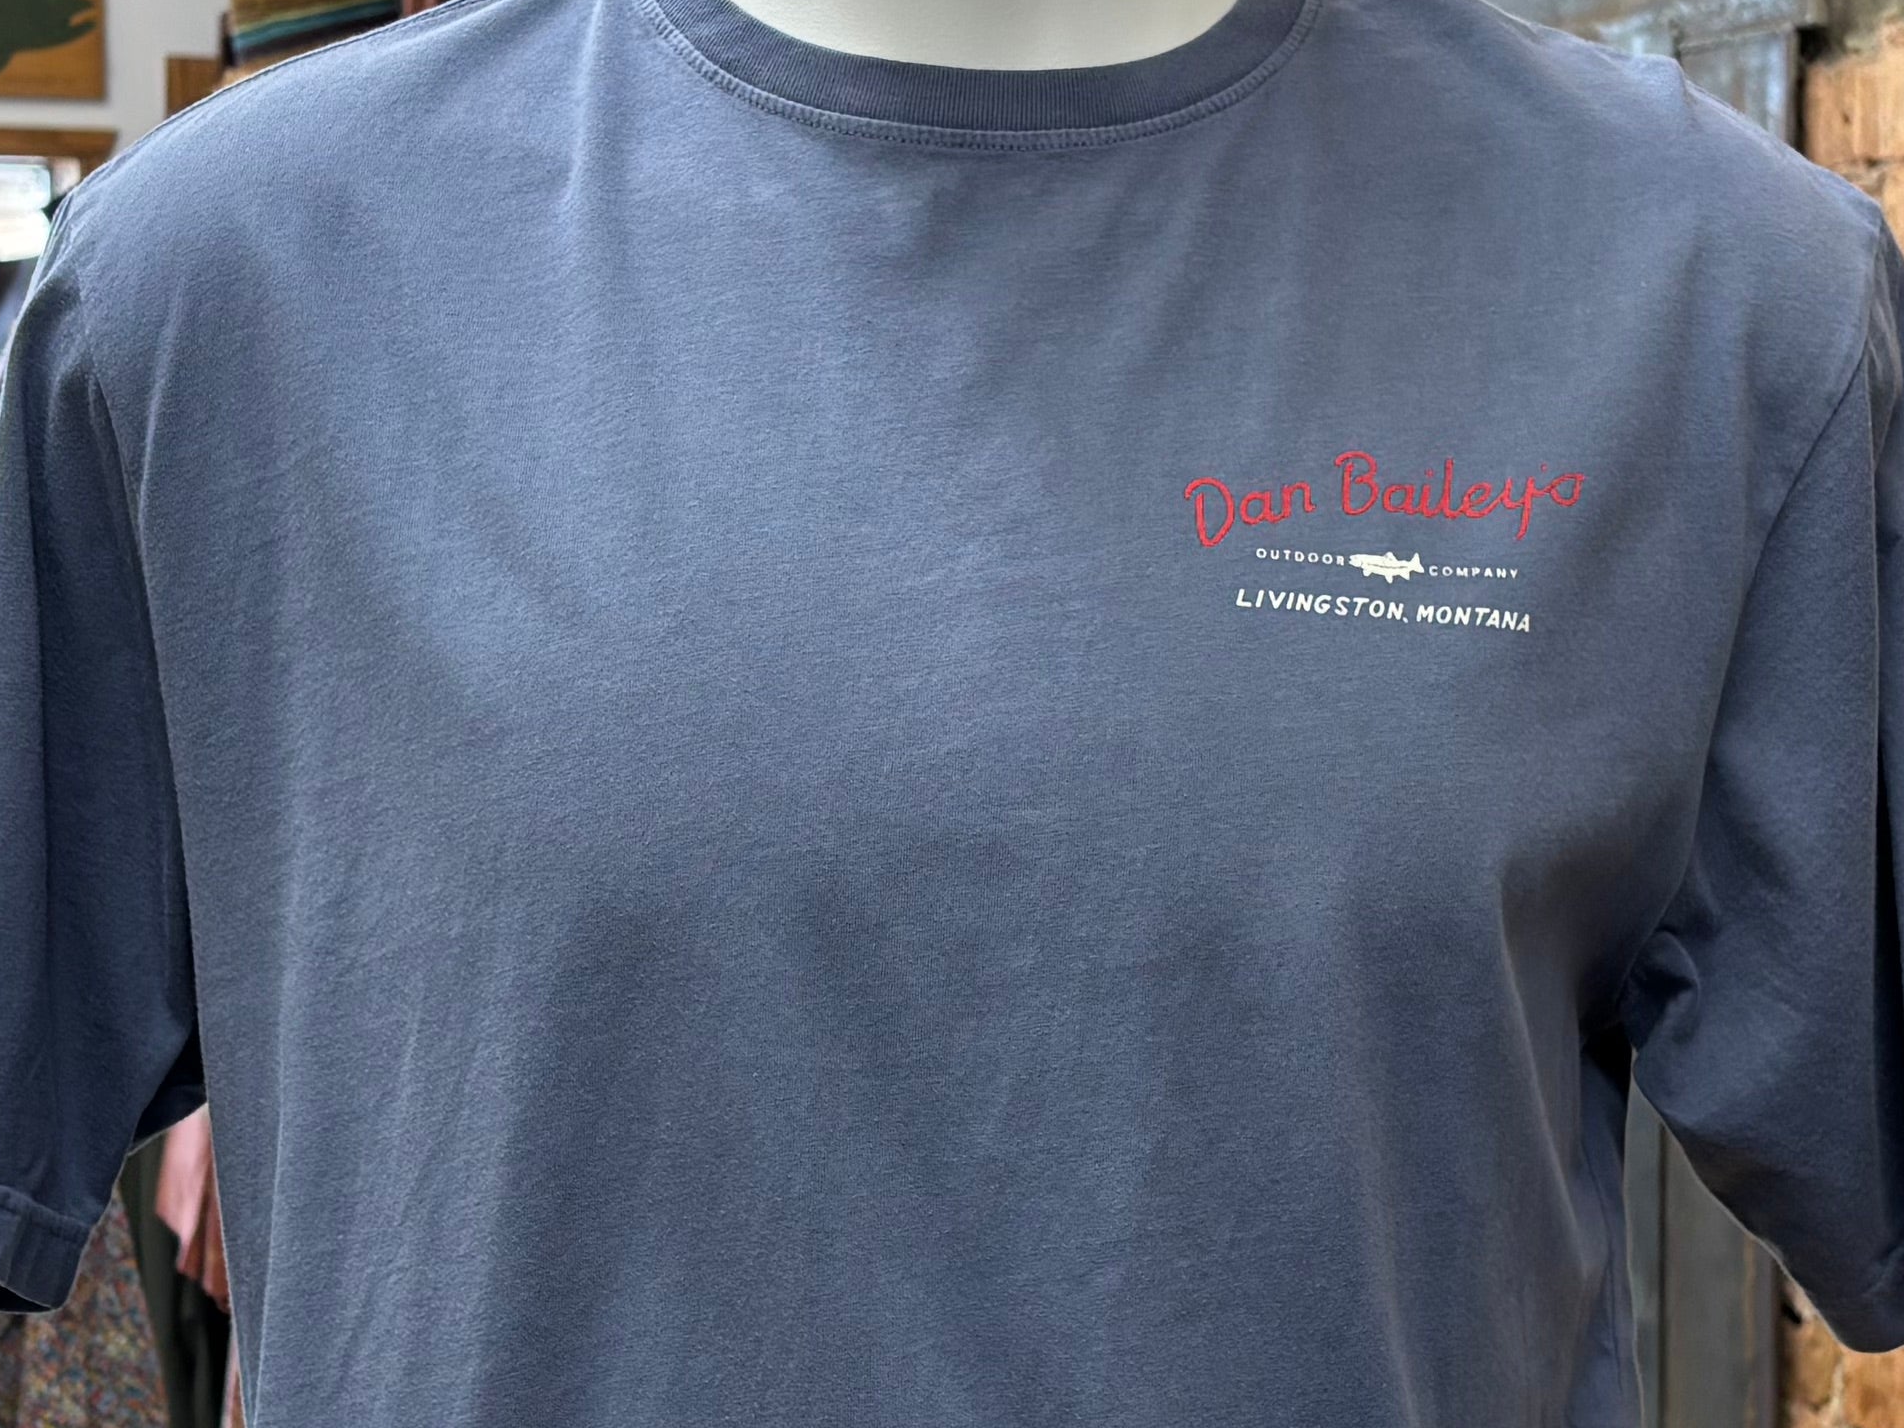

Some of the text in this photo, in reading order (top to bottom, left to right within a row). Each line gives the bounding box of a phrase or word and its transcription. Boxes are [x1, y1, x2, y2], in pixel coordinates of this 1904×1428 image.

[1183, 450, 1587, 548] Dan Bailey's
[1256, 547, 1520, 580] OUTDOOR COMPANY
[1235, 588, 1532, 634] LIVINGSTON, MONTANA
